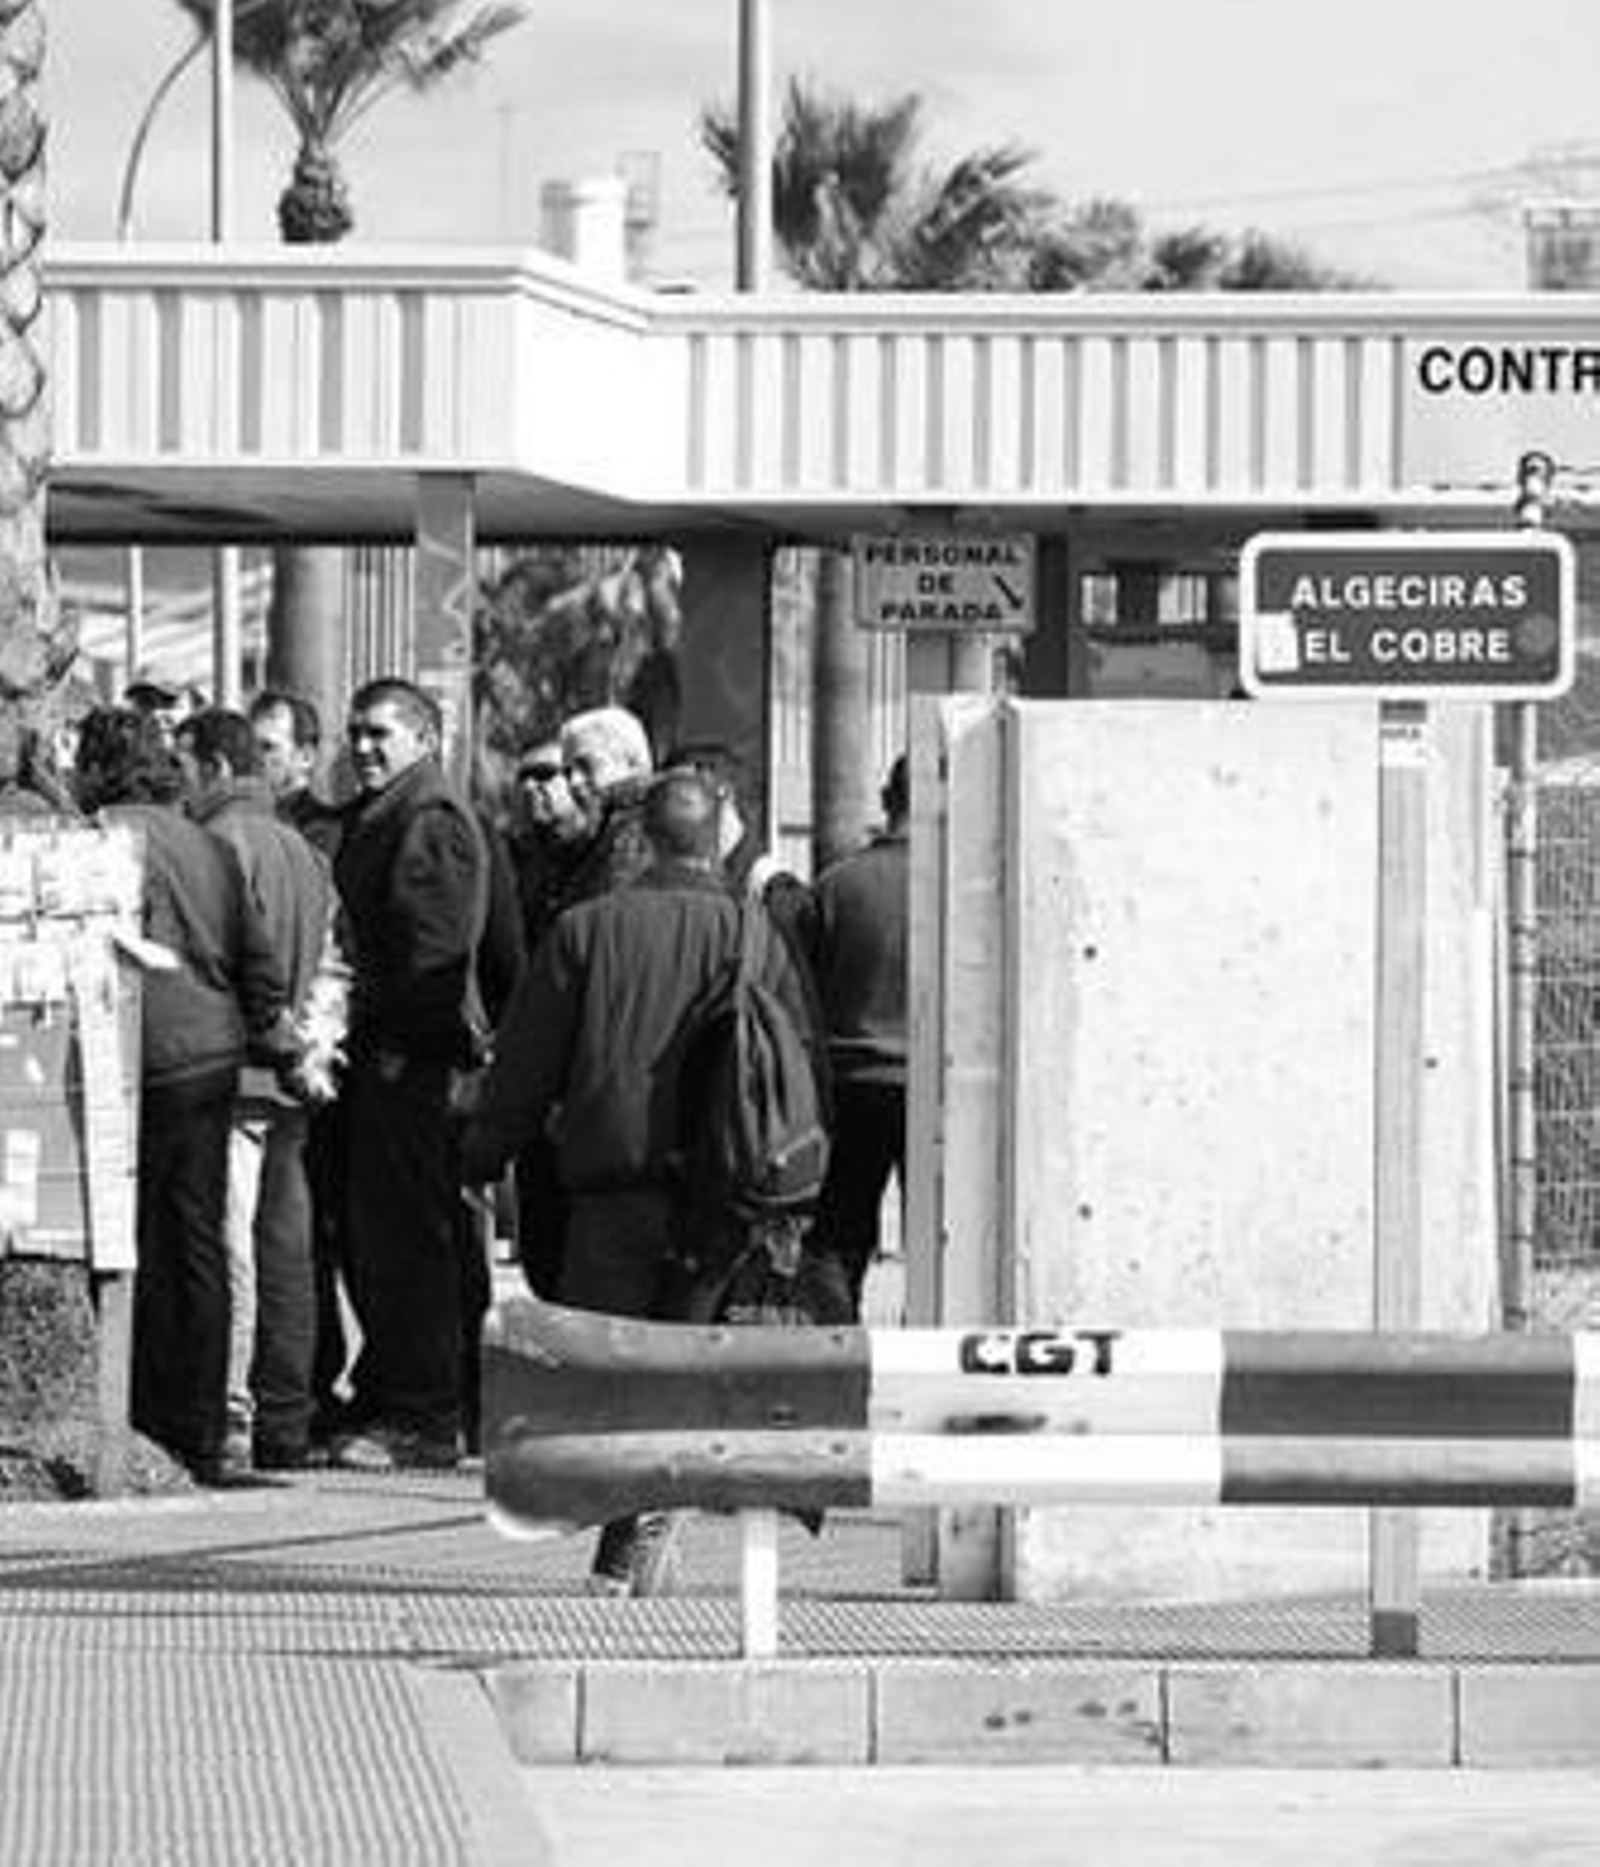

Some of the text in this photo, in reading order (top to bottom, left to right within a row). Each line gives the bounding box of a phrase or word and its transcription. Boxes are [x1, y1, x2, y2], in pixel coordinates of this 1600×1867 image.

[1419, 346, 1600, 393] CONTR
[865, 545, 1021, 566] PERSONAL
[918, 573, 954, 595] DE
[1292, 574, 1528, 608] ALGECIRAS
[880, 602, 1003, 621] PARADA
[1305, 630, 1511, 663] EL COBRE
[959, 1331, 1123, 1376] CGT
